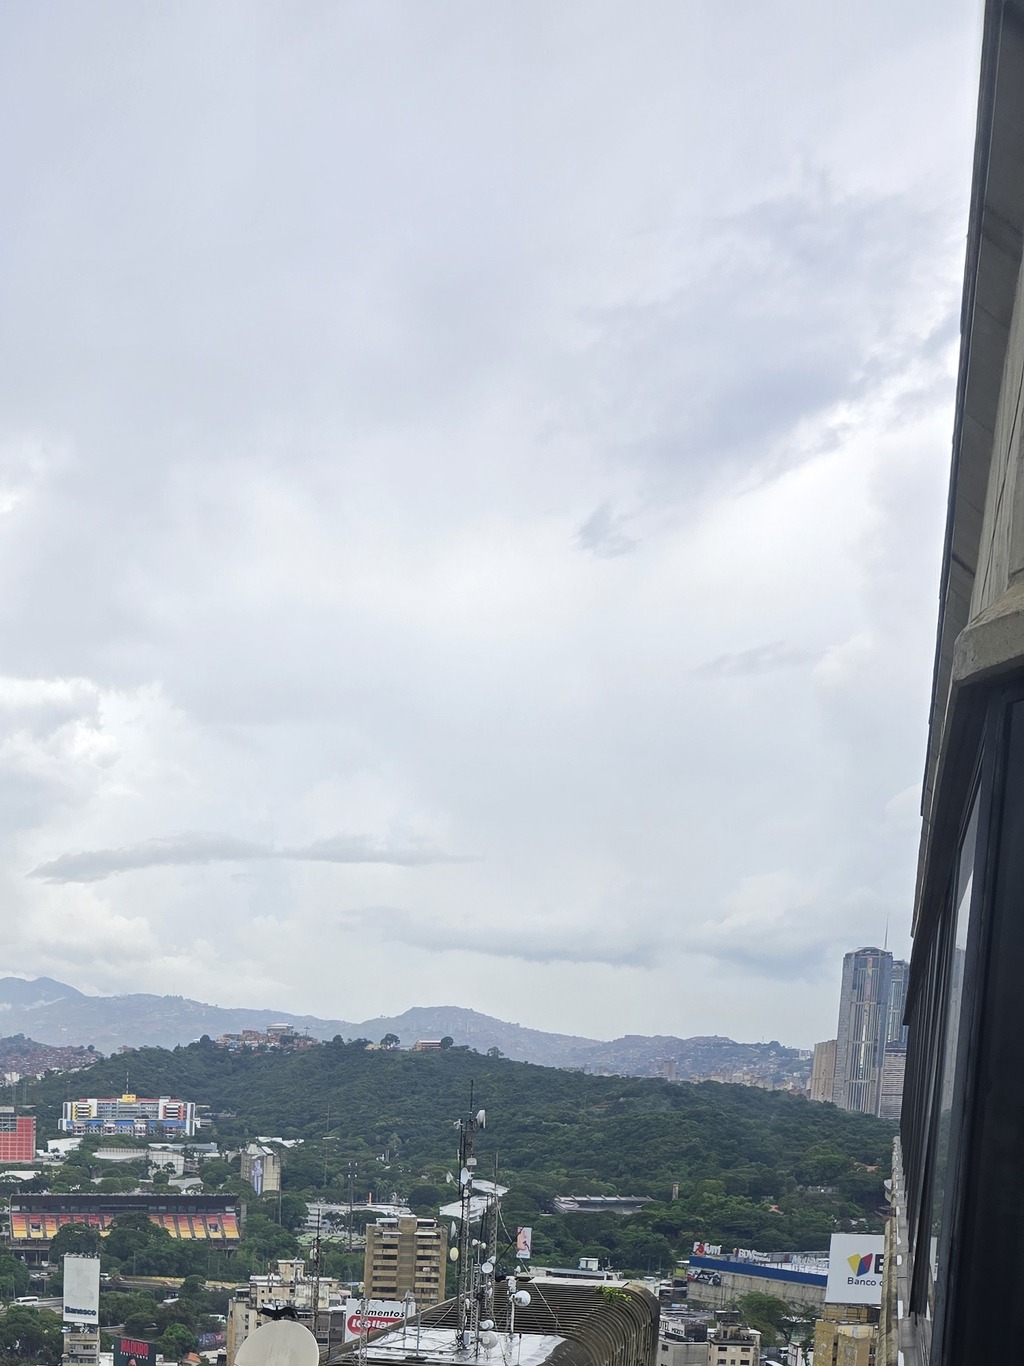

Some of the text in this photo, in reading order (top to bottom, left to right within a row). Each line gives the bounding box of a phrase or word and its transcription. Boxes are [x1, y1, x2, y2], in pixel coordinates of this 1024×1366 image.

[847, 1276, 877, 1286] Banco
[65, 1306, 96, 1316] Banesco
[355, 1309, 405, 1317] aimentos
[120, 1338, 149, 1356] MADURO
